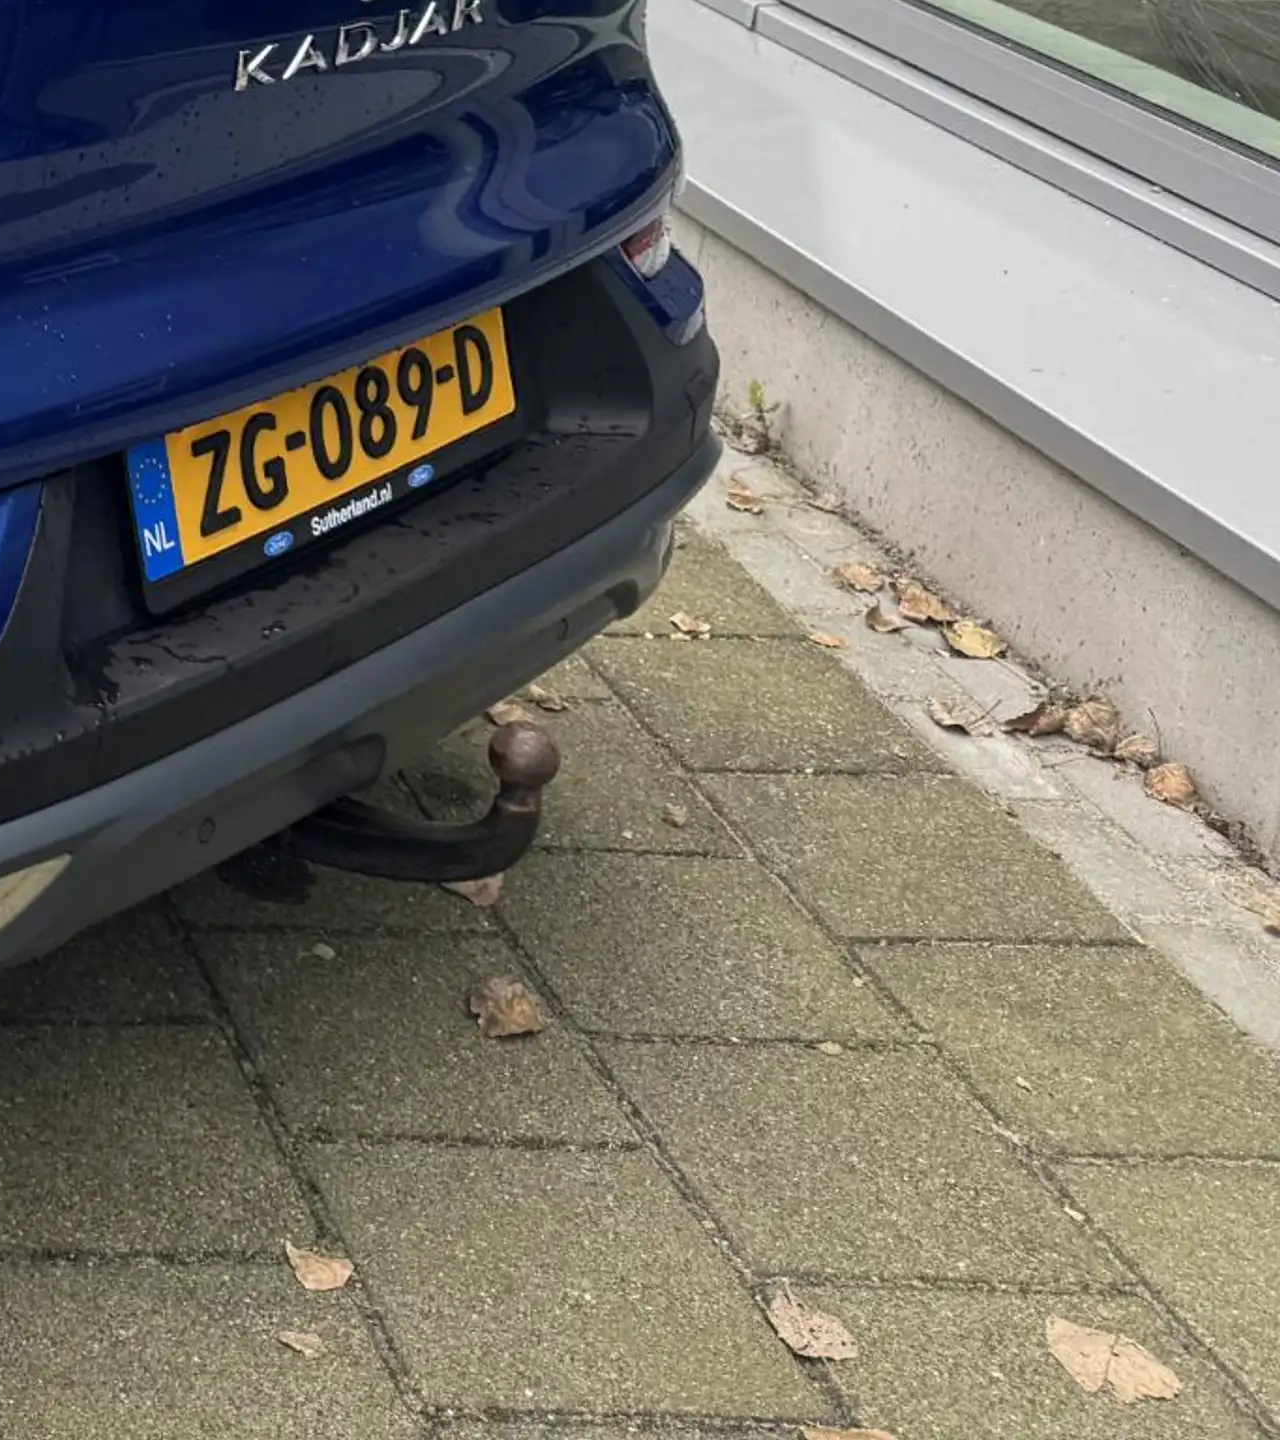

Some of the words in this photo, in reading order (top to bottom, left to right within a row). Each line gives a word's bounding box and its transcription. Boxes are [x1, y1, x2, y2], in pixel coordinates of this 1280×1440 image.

[192, 325, 493, 537] ZG-089-D
[311, 481, 393, 536] Sutherland.nl
[143, 520, 175, 557] NL
